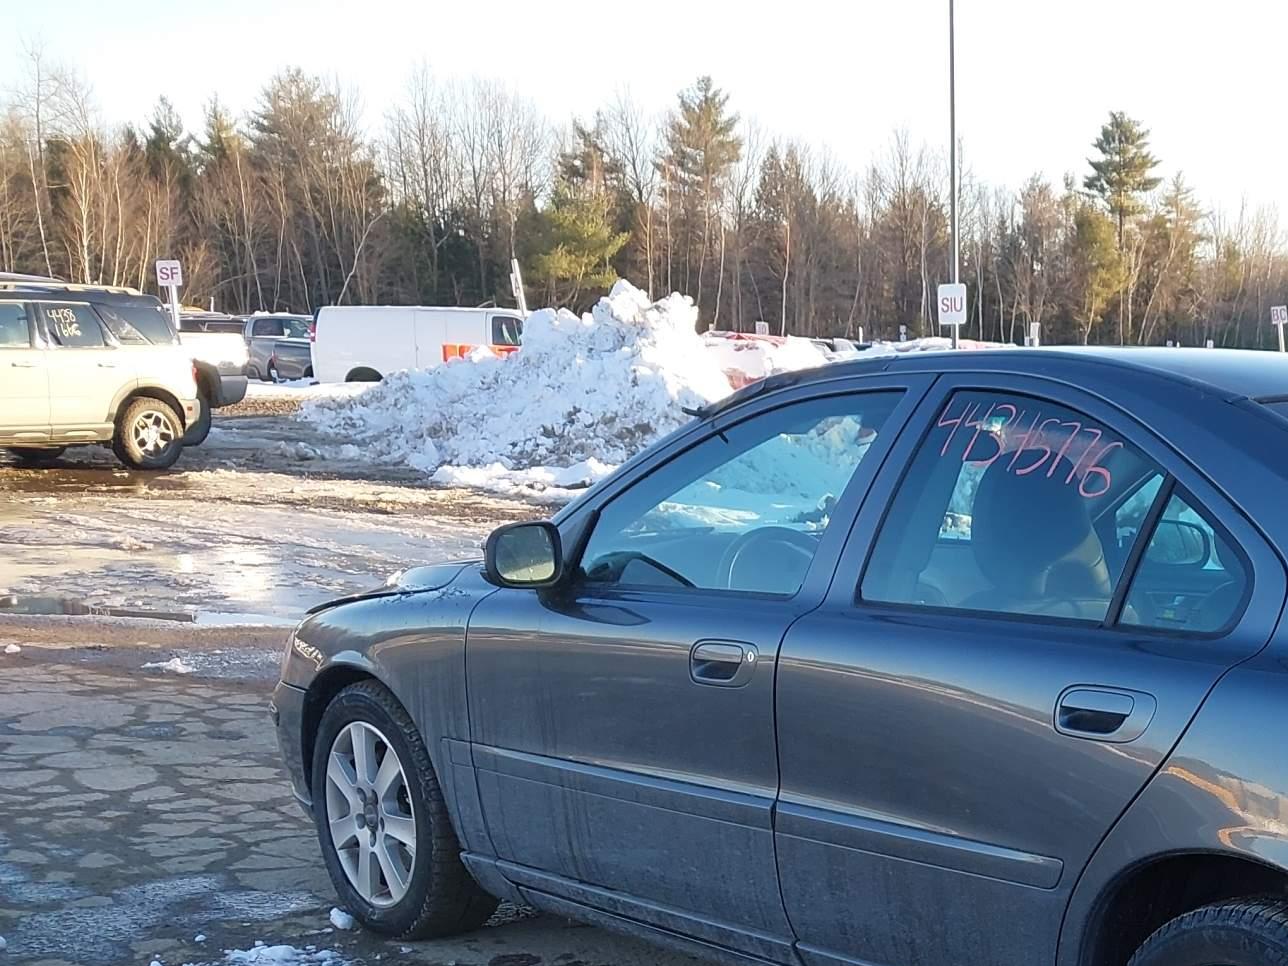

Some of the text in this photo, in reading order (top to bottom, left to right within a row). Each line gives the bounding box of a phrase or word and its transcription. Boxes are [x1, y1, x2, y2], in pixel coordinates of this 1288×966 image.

[159, 266, 179, 281] SF
[940, 296, 963, 313] SIU
[46, 308, 76, 323] 4438
[1272, 308, 1287, 321] BC
[937, 399, 1124, 498] 44345776
